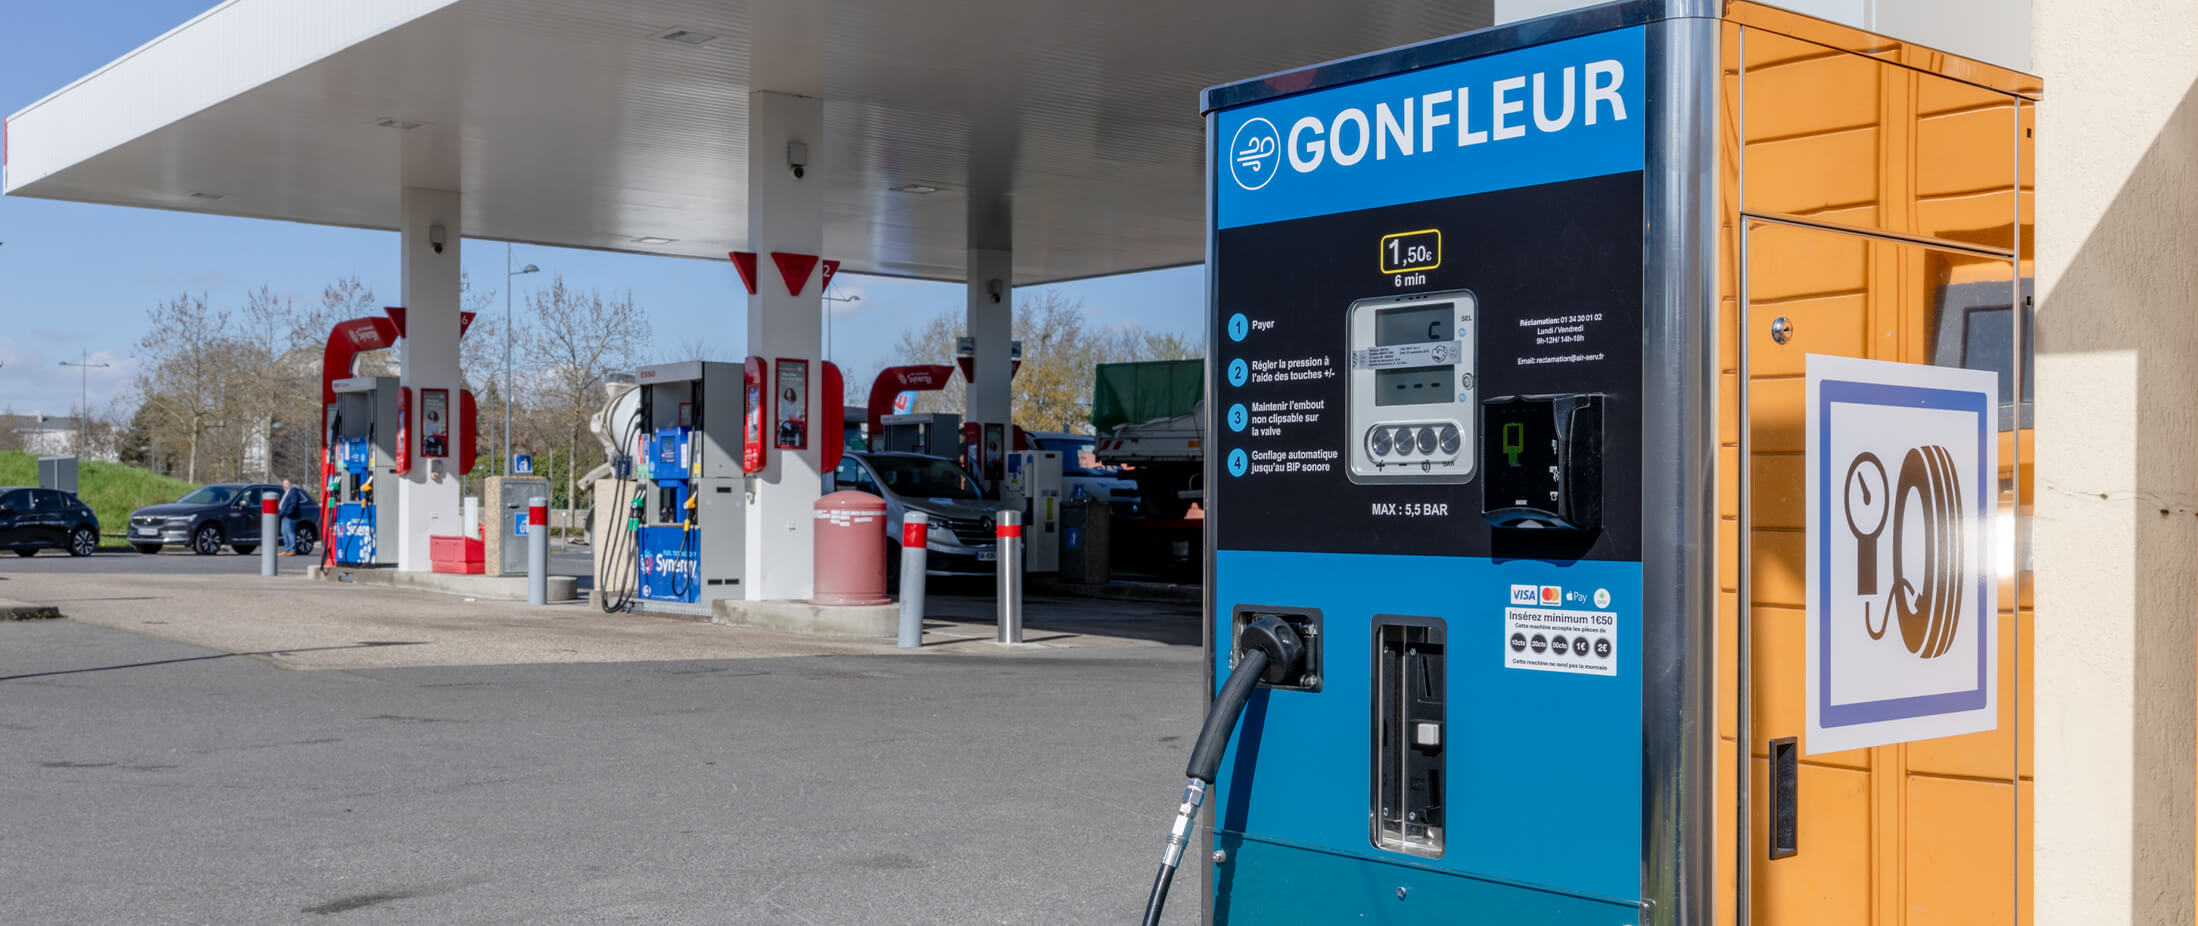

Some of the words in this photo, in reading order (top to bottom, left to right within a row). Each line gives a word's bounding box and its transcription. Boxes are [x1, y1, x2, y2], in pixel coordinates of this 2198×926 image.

[1287, 59, 1628, 173] GONFLEUR
[1388, 238, 1433, 267] 1,50€
[1394, 274, 1402, 288] 6
[1404, 272, 1426, 287] min
[1252, 320, 1275, 331] Payer
[1519, 317, 1560, 327] Réclamation:
[1568, 315, 1577, 323] 34
[1594, 313, 1603, 321] 02
[1235, 320, 1241, 334] 1
[1537, 326, 1554, 335] Lundi
[1557, 324, 1584, 334] Vendredi
[1252, 360, 1278, 372] Régler
[1278, 359, 1286, 369] la
[1287, 357, 1323, 370] pression
[1323, 355, 1330, 366] à
[1517, 357, 1536, 366] Email:
[1234, 366, 1242, 379] 2
[1252, 372, 1273, 382] l'aide
[1274, 371, 1289, 381] des
[1290, 369, 1323, 380] touches
[1251, 401, 1288, 412] Maintenir
[1289, 399, 1324, 410] l'embout
[1234, 411, 1241, 424] 3
[1251, 415, 1267, 424] non
[1268, 413, 1304, 425] clipsable
[1304, 414, 1319, 422] sur
[1252, 426, 1259, 436] la
[1259, 426, 1281, 436] valve
[1251, 450, 1287, 462] Gonflage
[1288, 449, 1338, 461] automatique
[1234, 456, 1241, 470] 4
[1251, 462, 1285, 475] jusqu'au
[1286, 462, 1301, 472] BIP
[1302, 463, 1330, 472] sonore
[1371, 503, 1396, 516] MAX
[1405, 503, 1421, 518] 5,5
[1423, 503, 1448, 516] BAR
[1513, 589, 1536, 601] VISA
[1573, 591, 1588, 604] Pay
[1509, 610, 1542, 622] Insérez
[1543, 612, 1588, 624] minimum
[1590, 615, 1613, 626] 1€50
[1576, 642, 1586, 651] 1€
[1597, 643, 1608, 653] 2€
